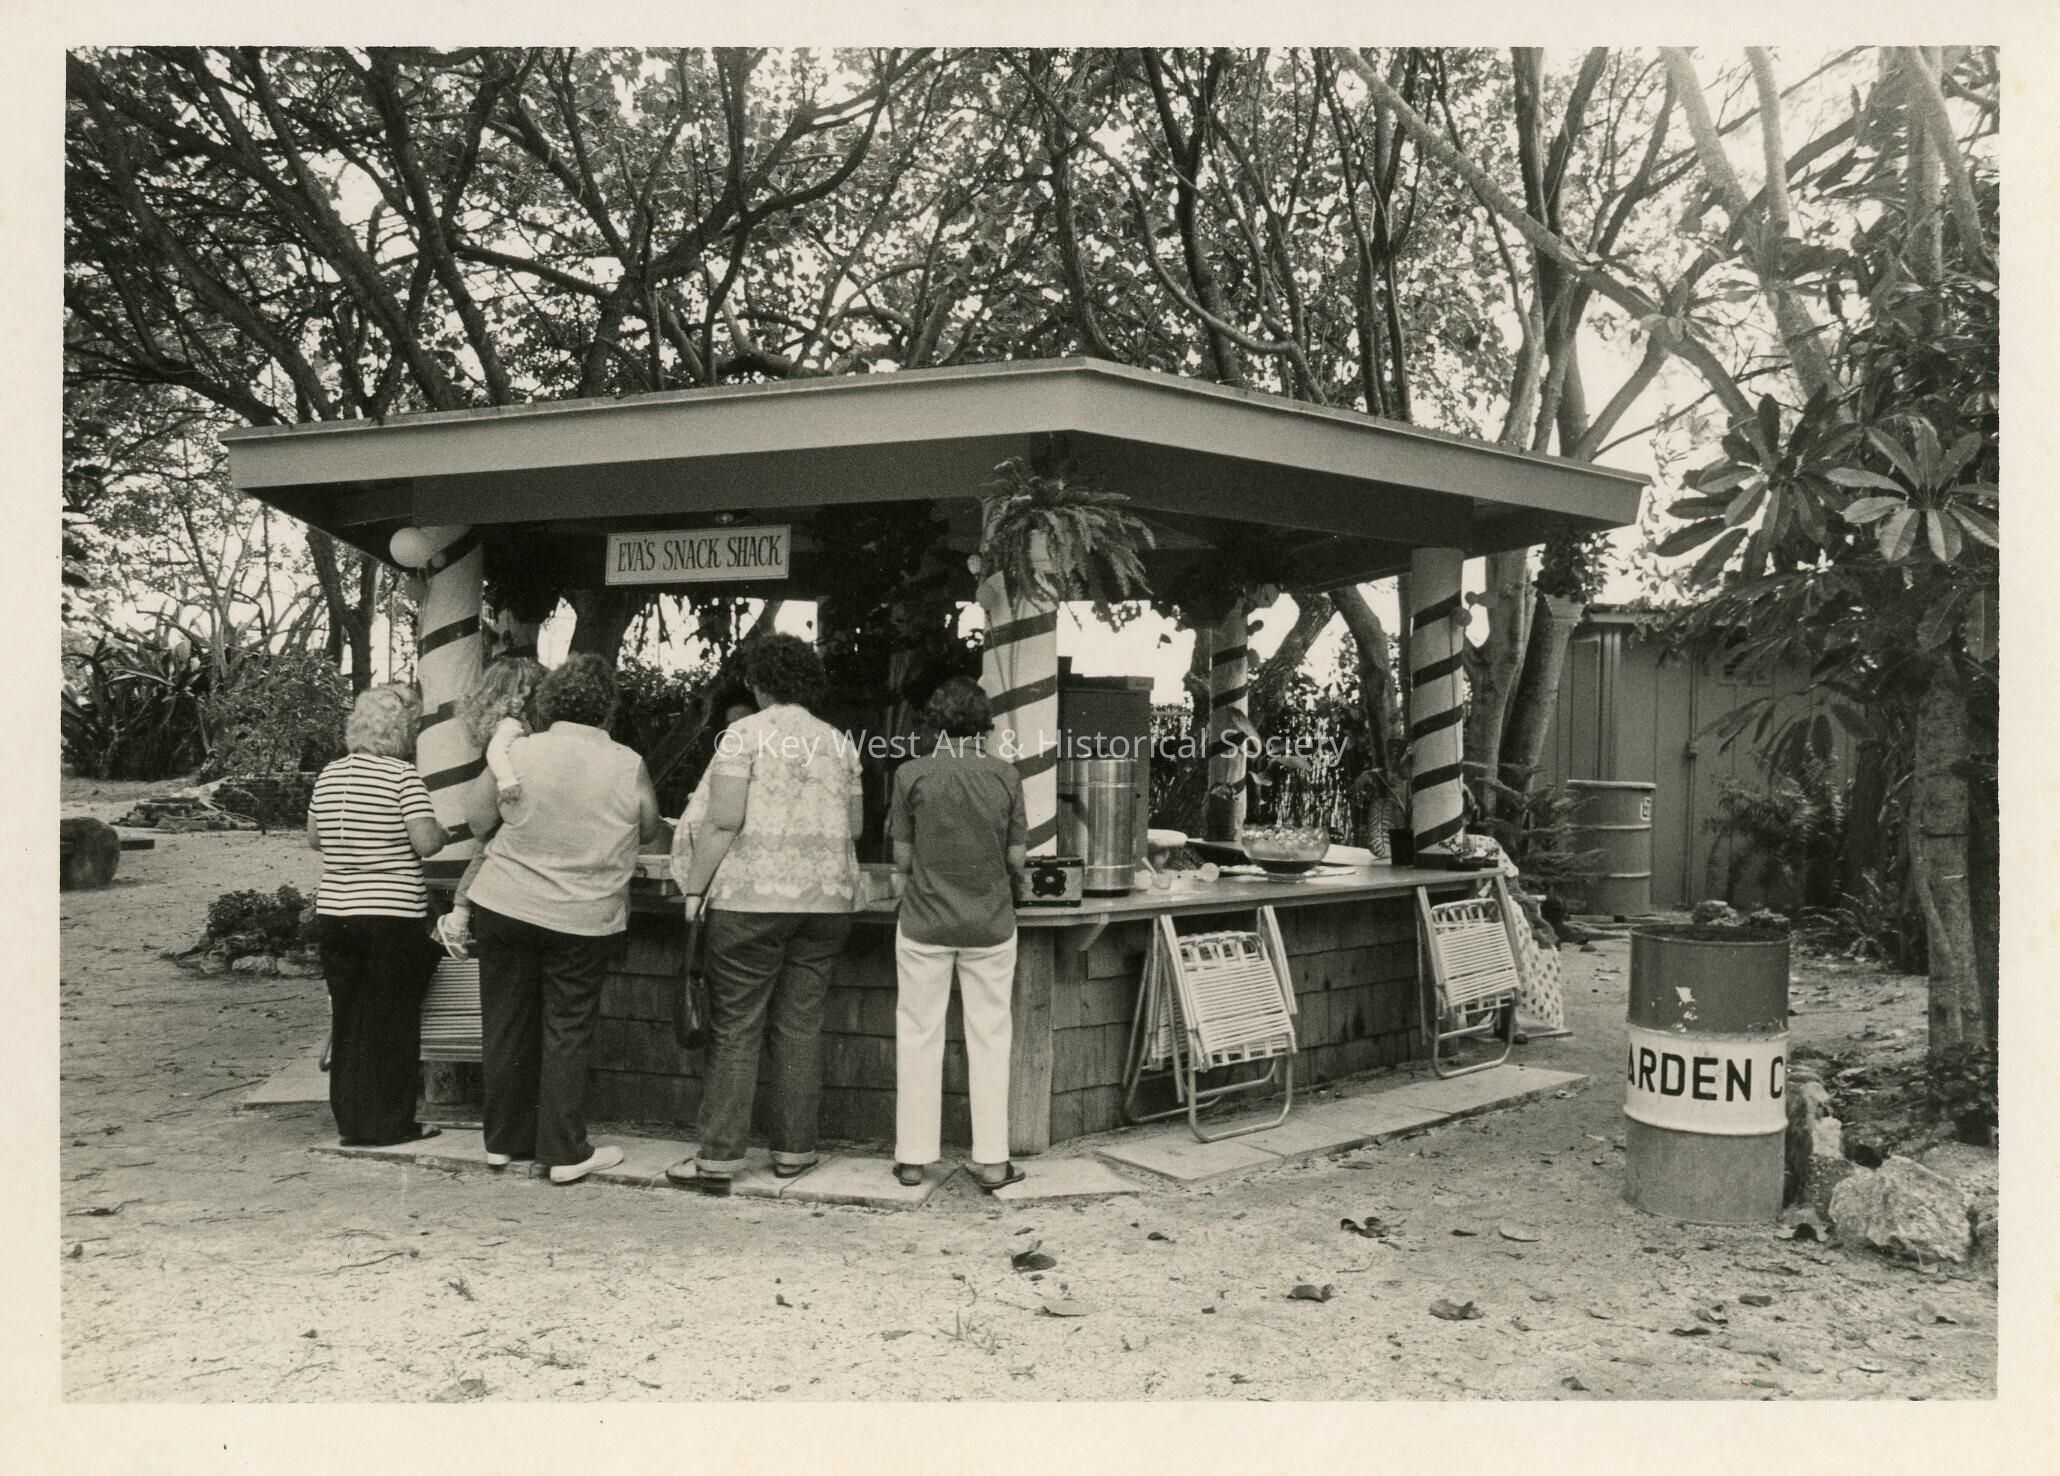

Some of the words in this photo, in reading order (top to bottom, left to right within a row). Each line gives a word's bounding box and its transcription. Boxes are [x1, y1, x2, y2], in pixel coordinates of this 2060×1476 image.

[617, 539, 656, 572] EVA'S
[663, 538, 721, 570] SNACK
[727, 535, 782, 567] SHACK
